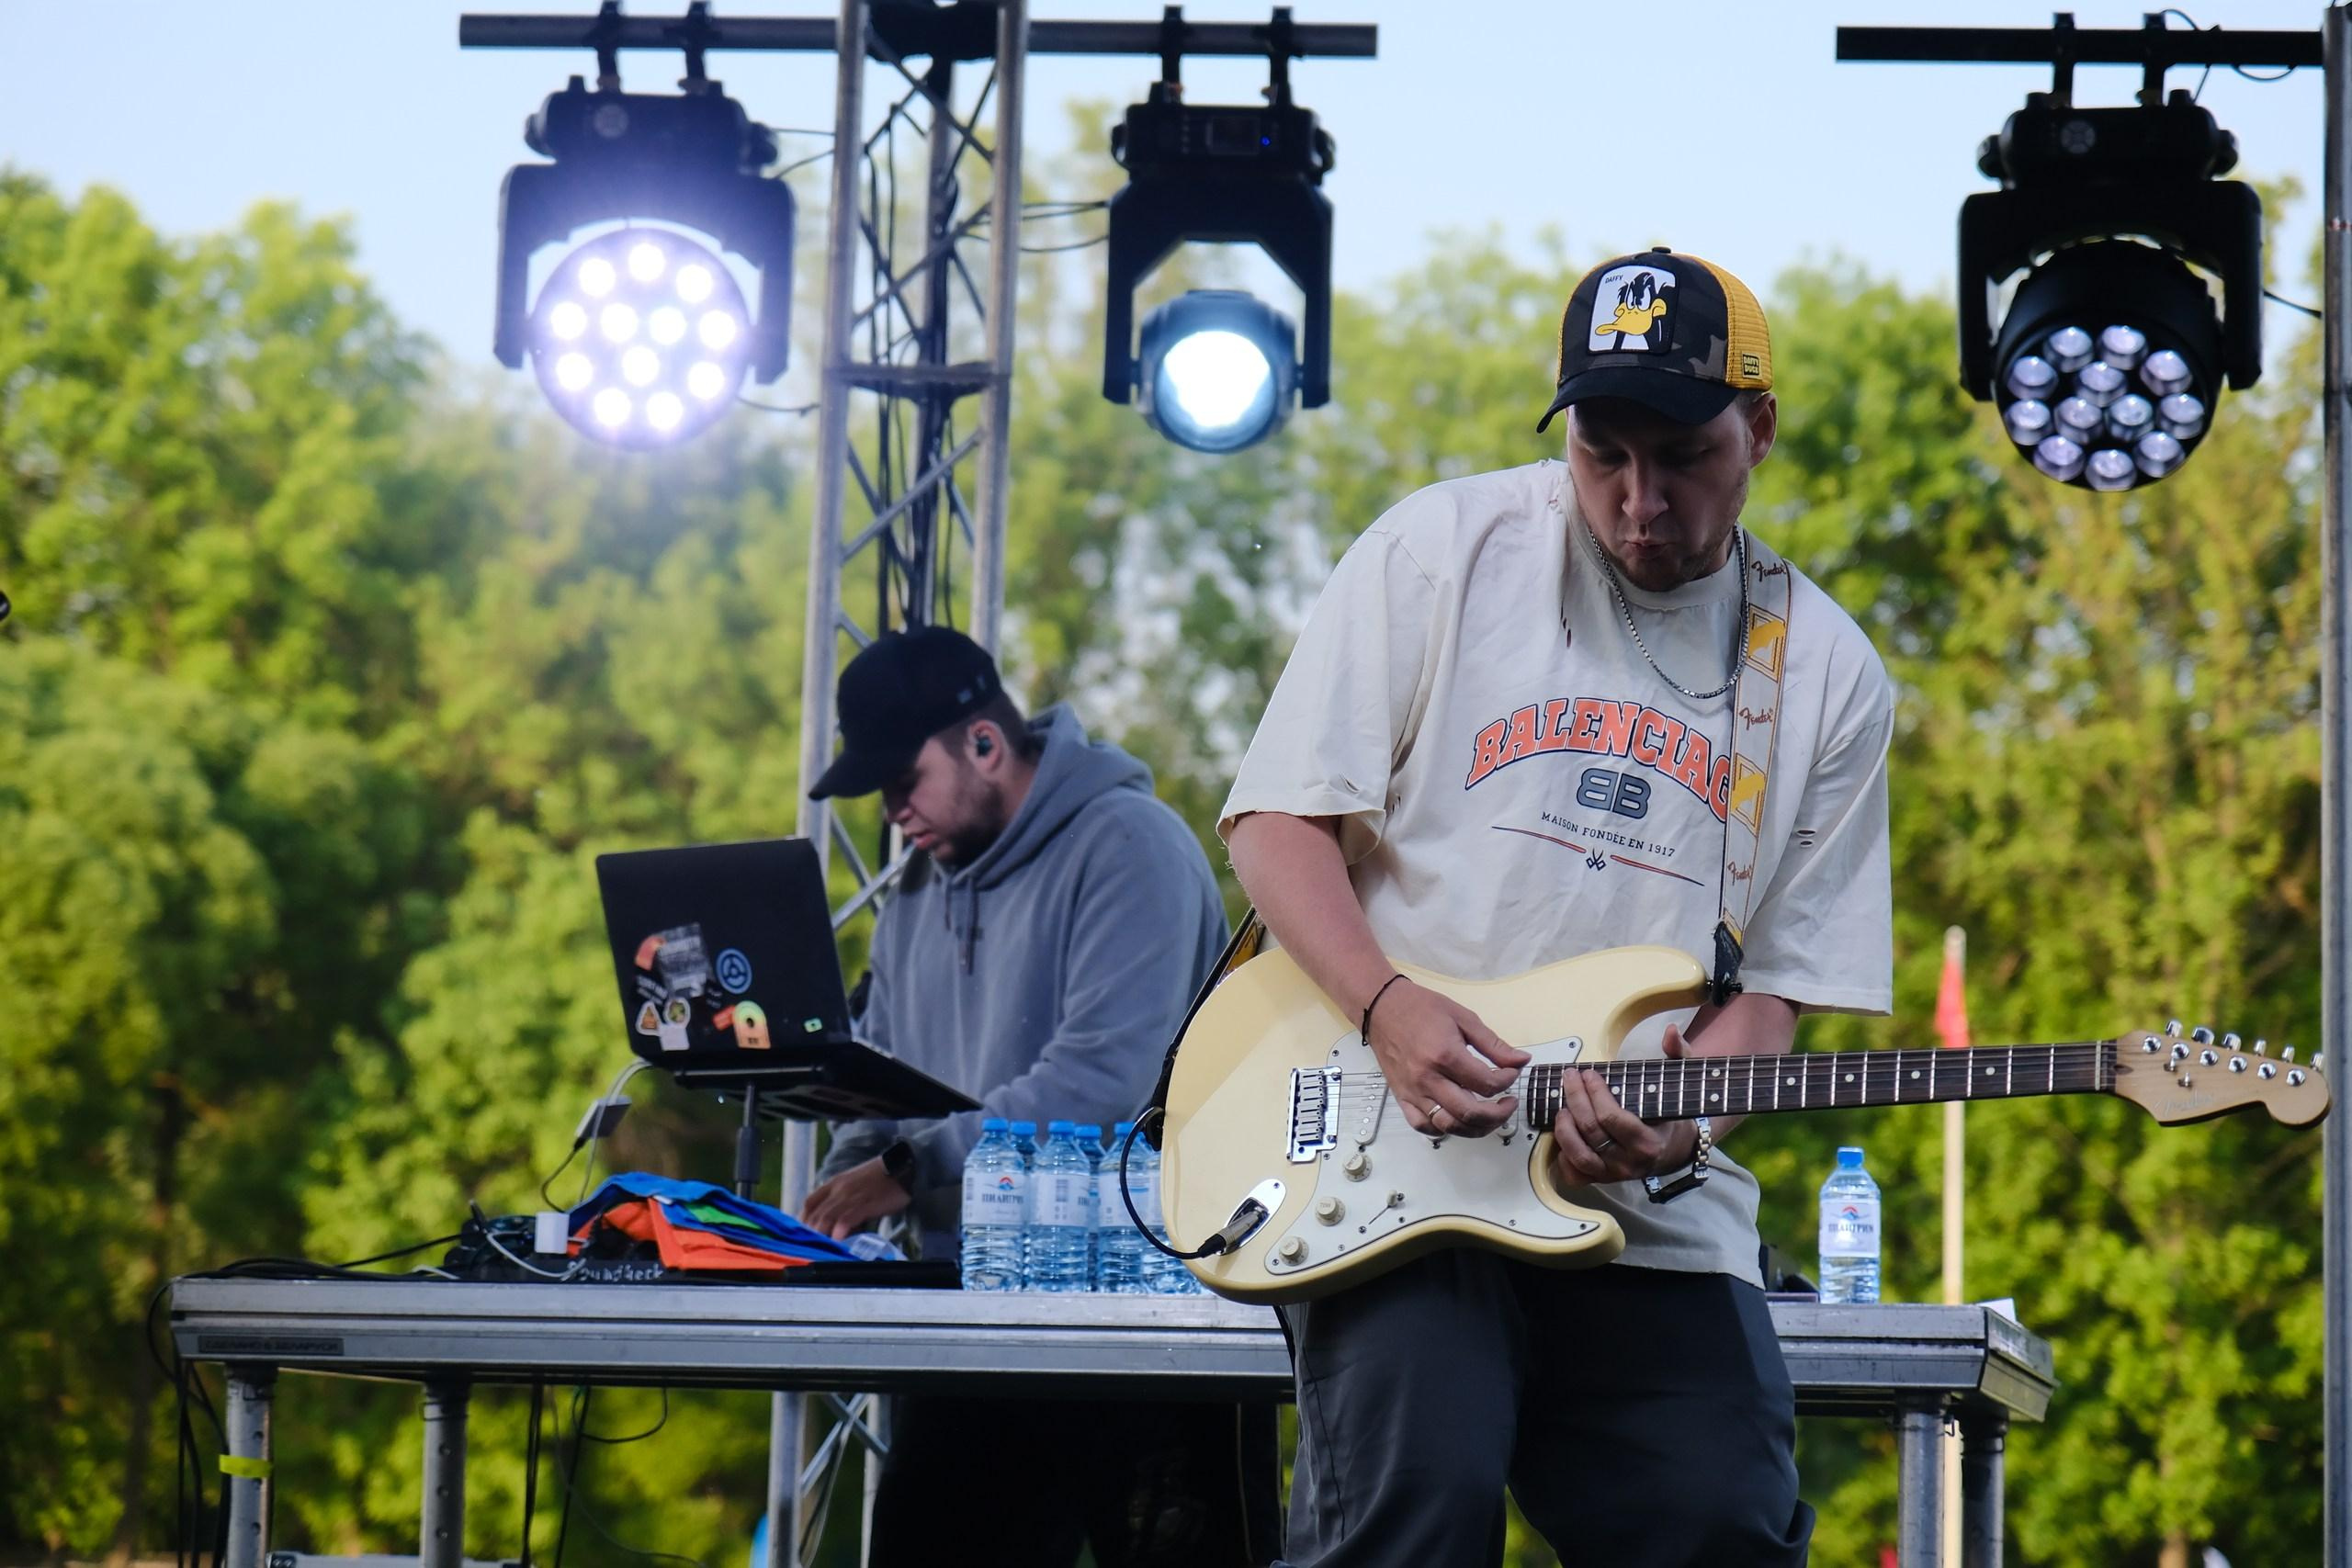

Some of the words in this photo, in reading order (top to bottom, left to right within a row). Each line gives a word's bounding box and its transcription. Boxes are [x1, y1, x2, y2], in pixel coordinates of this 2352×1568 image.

[1605, 274, 1623, 284] DAFFY
[1751, 560, 1786, 582] Fender
[1739, 706, 1773, 730] Fender
[1542, 811, 1578, 832] MAISON
[1582, 827, 1626, 845] FONDÉE
[1628, 838, 1645, 850] EN
[1648, 843, 1675, 857] 1917
